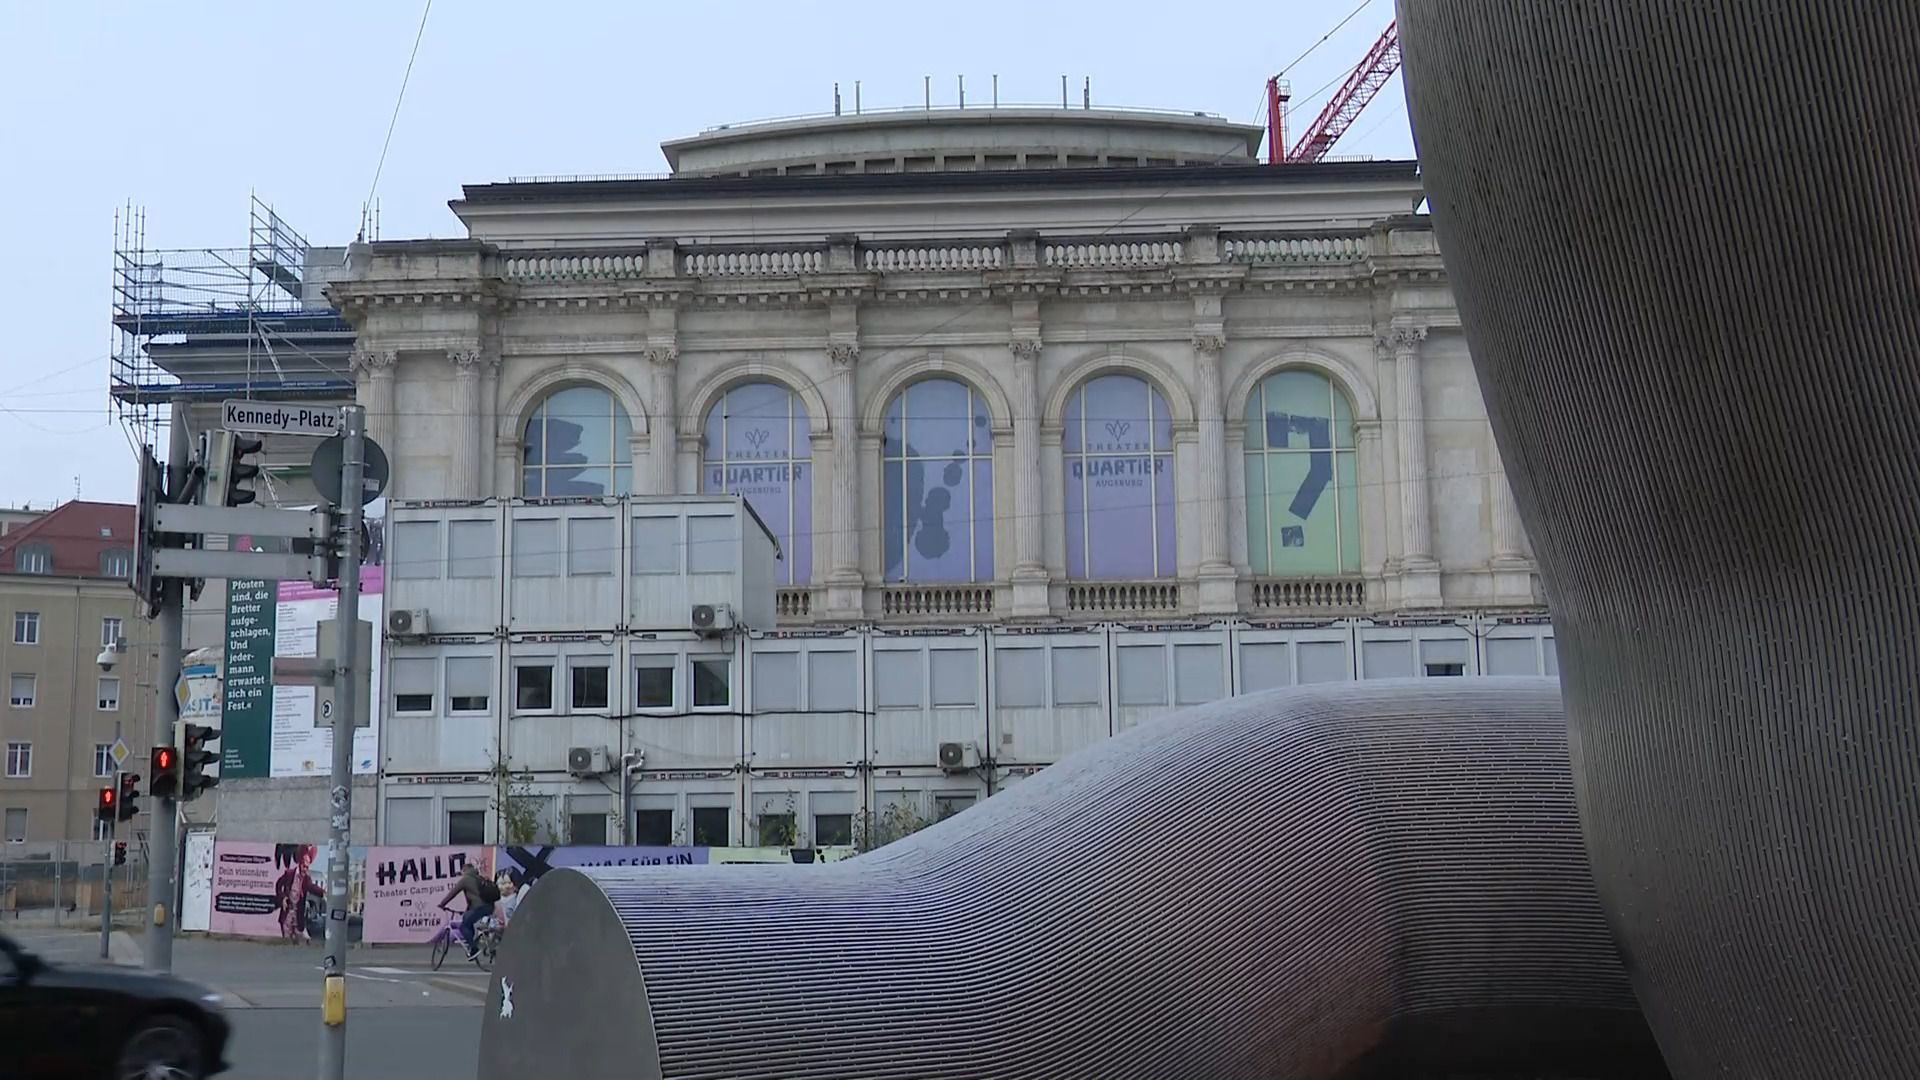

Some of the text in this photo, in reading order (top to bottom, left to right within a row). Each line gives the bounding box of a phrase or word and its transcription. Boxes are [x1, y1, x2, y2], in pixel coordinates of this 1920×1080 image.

[227, 405, 334, 429] Kennedy-Platz
[232, 580, 265, 590] Pfosten
[232, 590, 269, 602] sind, die
[231, 604, 261, 614] Bretter
[230, 616, 258, 627] aufge-
[230, 628, 271, 639] schlagen,
[230, 640, 248, 650] Und
[229, 653, 254, 664] jeder-
[229, 665, 255, 674] mann
[228, 676, 265, 686] erwartet
[228, 688, 262, 699] sich ein
[218, 867, 234, 876] Dein
[376, 853, 466, 886] HALLO
[374, 886, 407, 898] Theater
[410, 883, 445, 896] Campus
